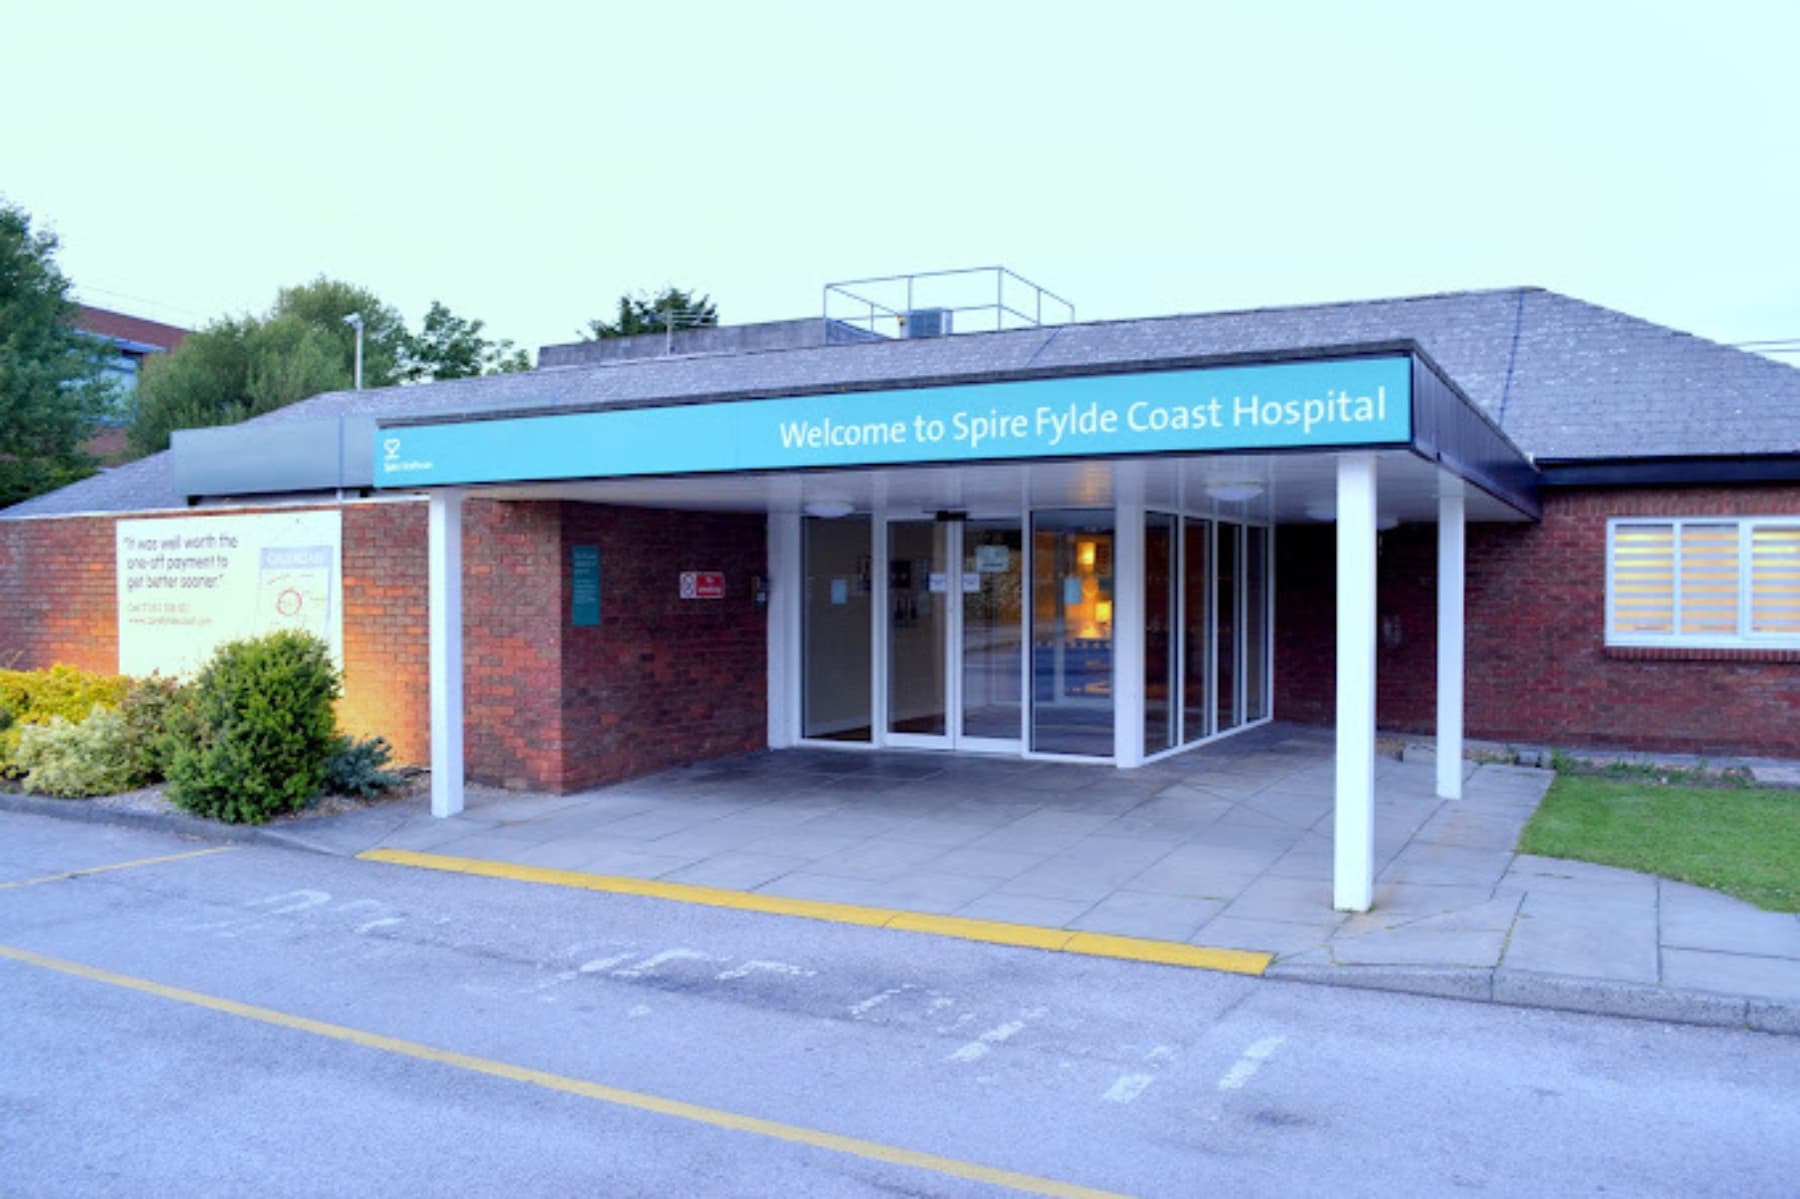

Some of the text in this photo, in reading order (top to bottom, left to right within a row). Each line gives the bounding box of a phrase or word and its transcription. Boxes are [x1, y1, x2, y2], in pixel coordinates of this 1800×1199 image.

[779, 385, 1386, 449] Welcome to Spire Fylde Coast Hospital
[137, 538, 158, 551] was
[161, 533, 181, 551] well
[184, 533, 216, 550] worth
[219, 532, 239, 549] the
[166, 555, 215, 573] payment
[216, 554, 229, 568] to
[146, 574, 178, 589] better
